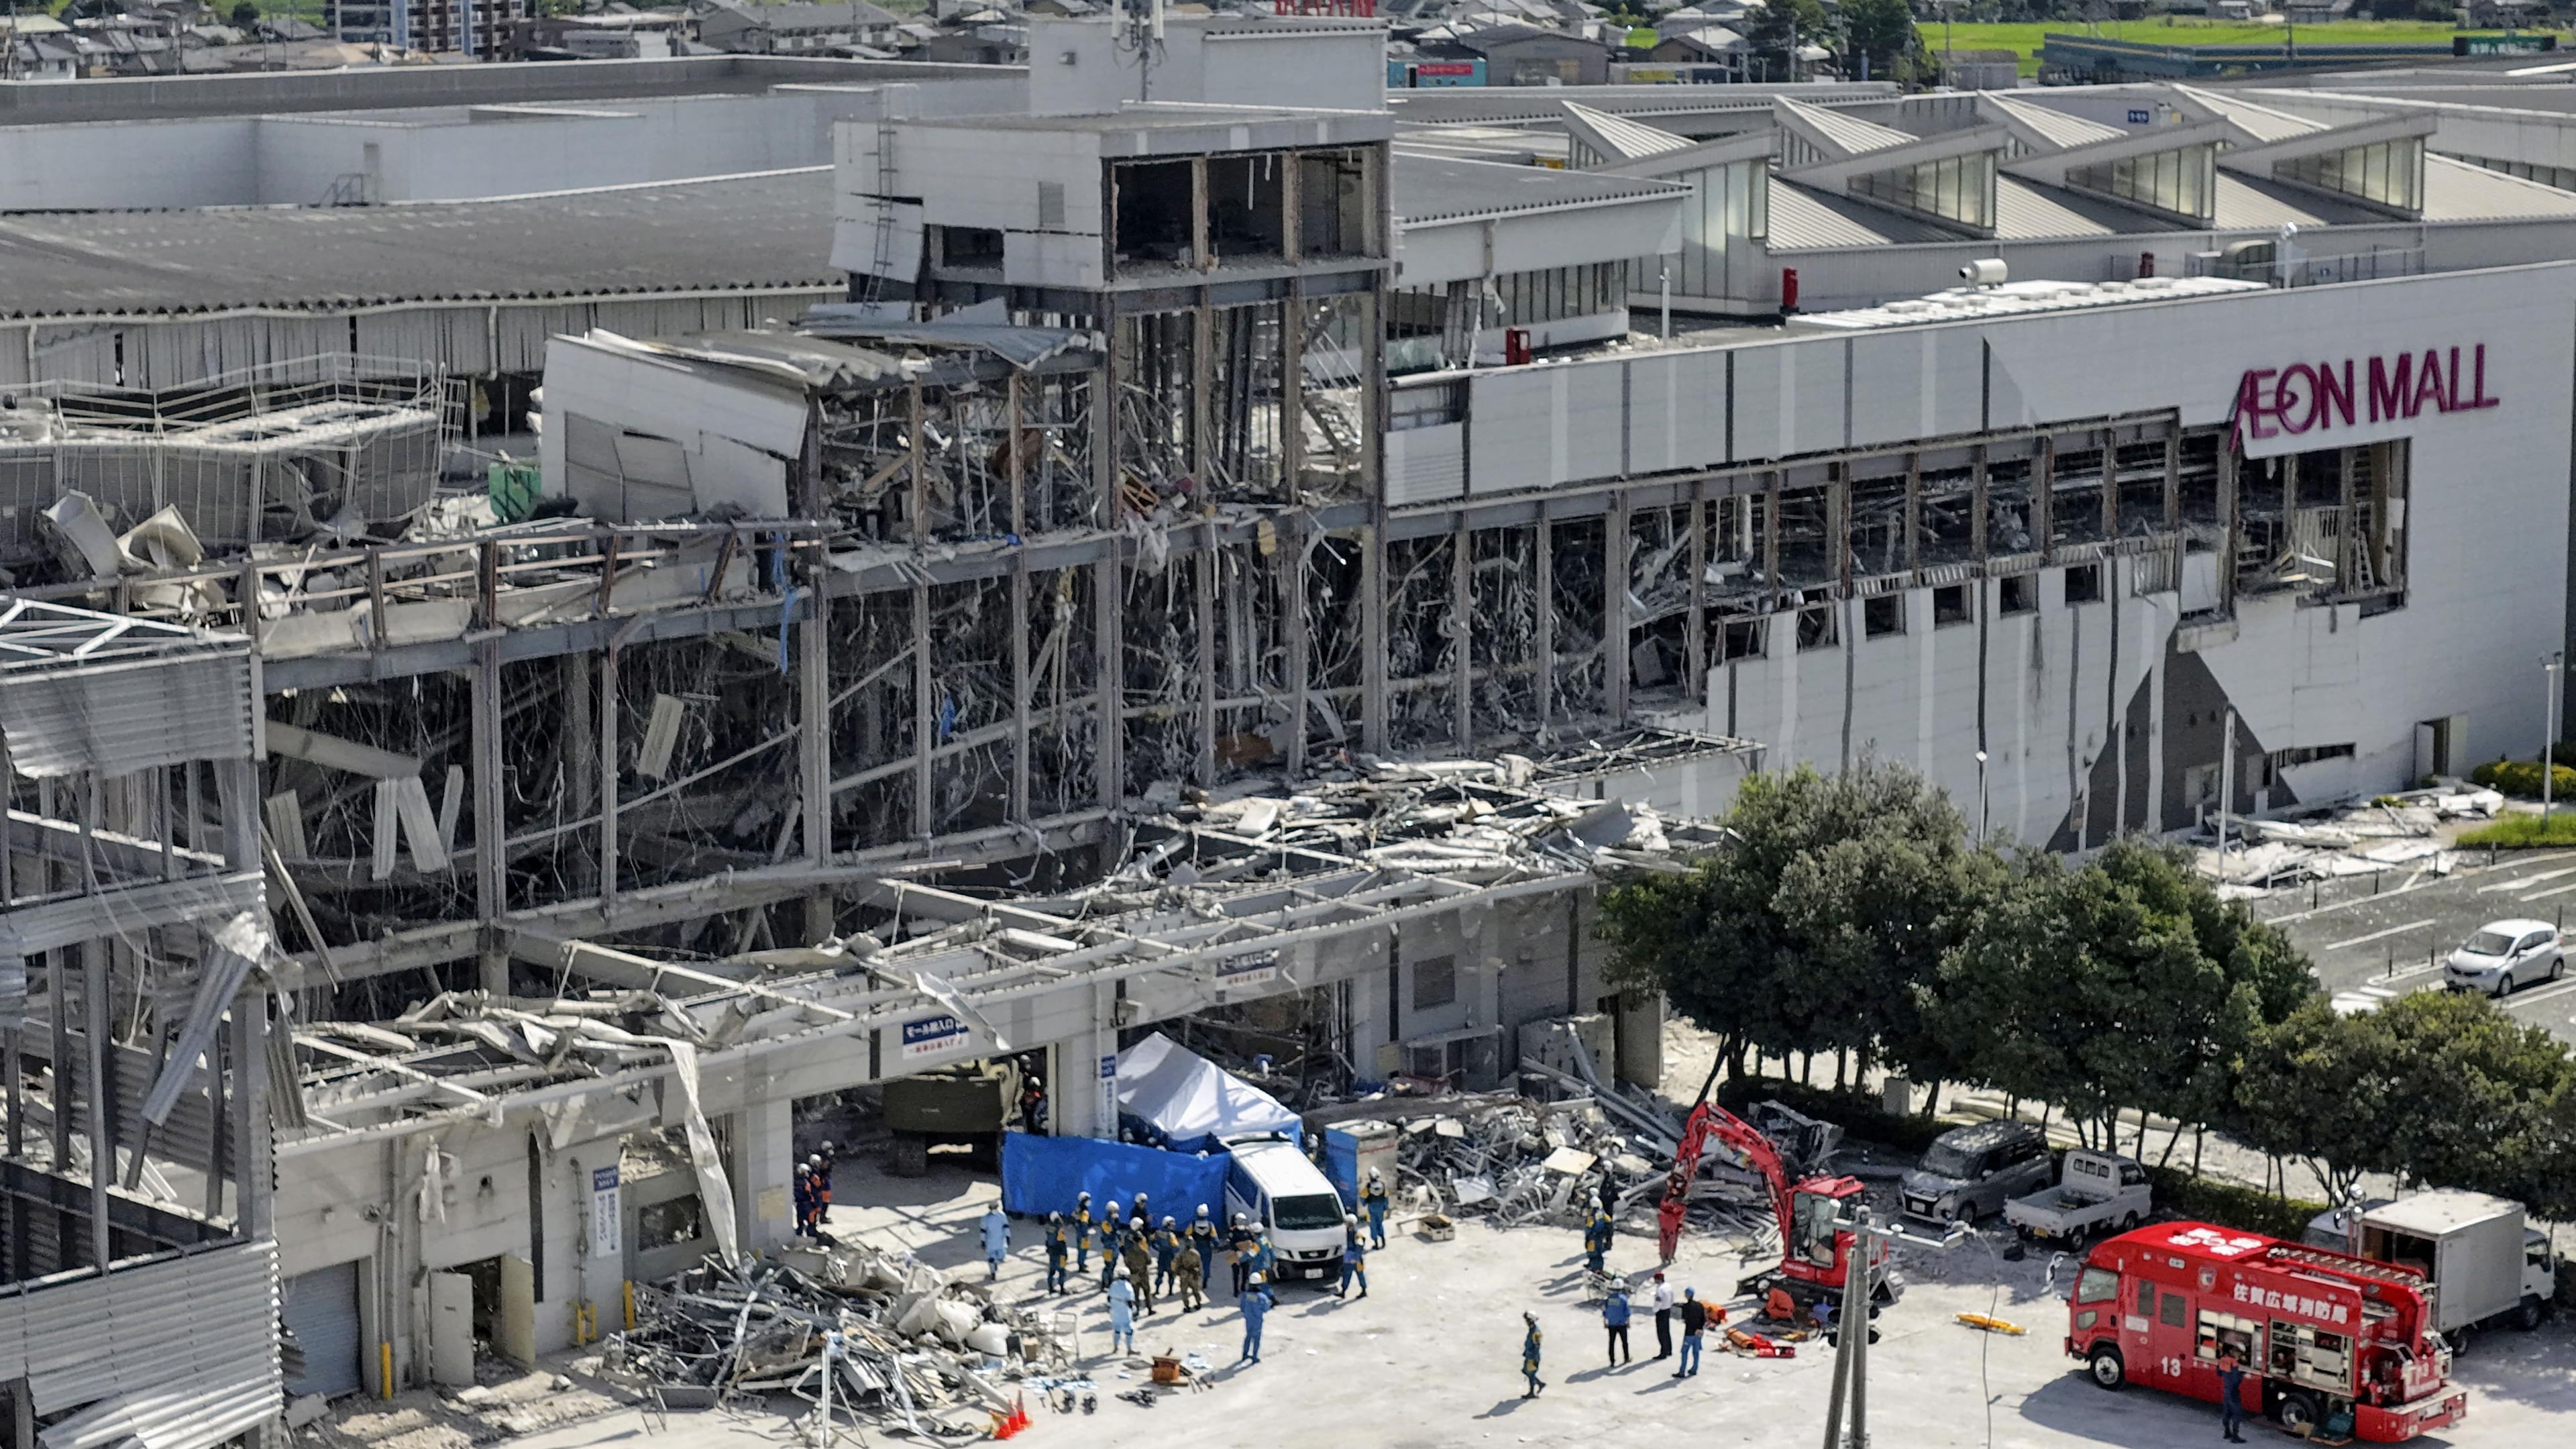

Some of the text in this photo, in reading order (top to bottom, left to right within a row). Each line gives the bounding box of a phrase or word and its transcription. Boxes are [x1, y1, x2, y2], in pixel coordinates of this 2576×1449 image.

[2369, 343, 2500, 423] MALL
[2233, 1282, 2348, 1325] 佐賀広域消防局
[2161, 1356, 2182, 1377] 13
